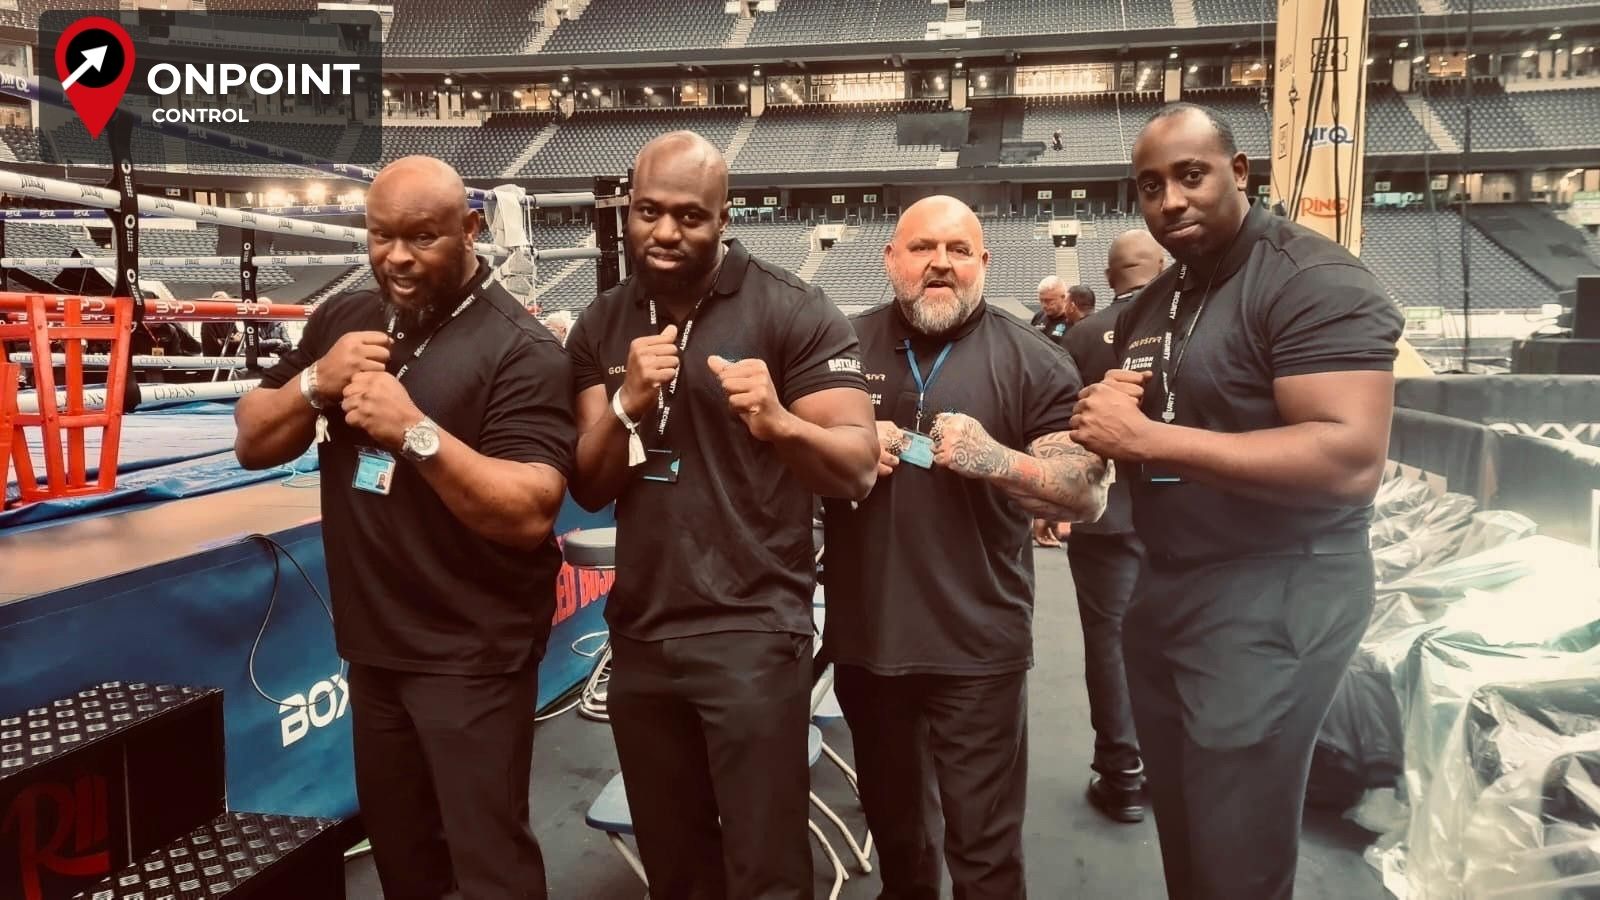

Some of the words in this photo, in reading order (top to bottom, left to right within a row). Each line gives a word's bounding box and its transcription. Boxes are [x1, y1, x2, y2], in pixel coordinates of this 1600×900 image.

[156, 302, 196, 314] BYD
[237, 304, 270, 315] BYD
[1169, 291, 1181, 320] SECURITY
[680, 320, 693, 351] SECURITY
[1163, 332, 1172, 360] SECURITY
